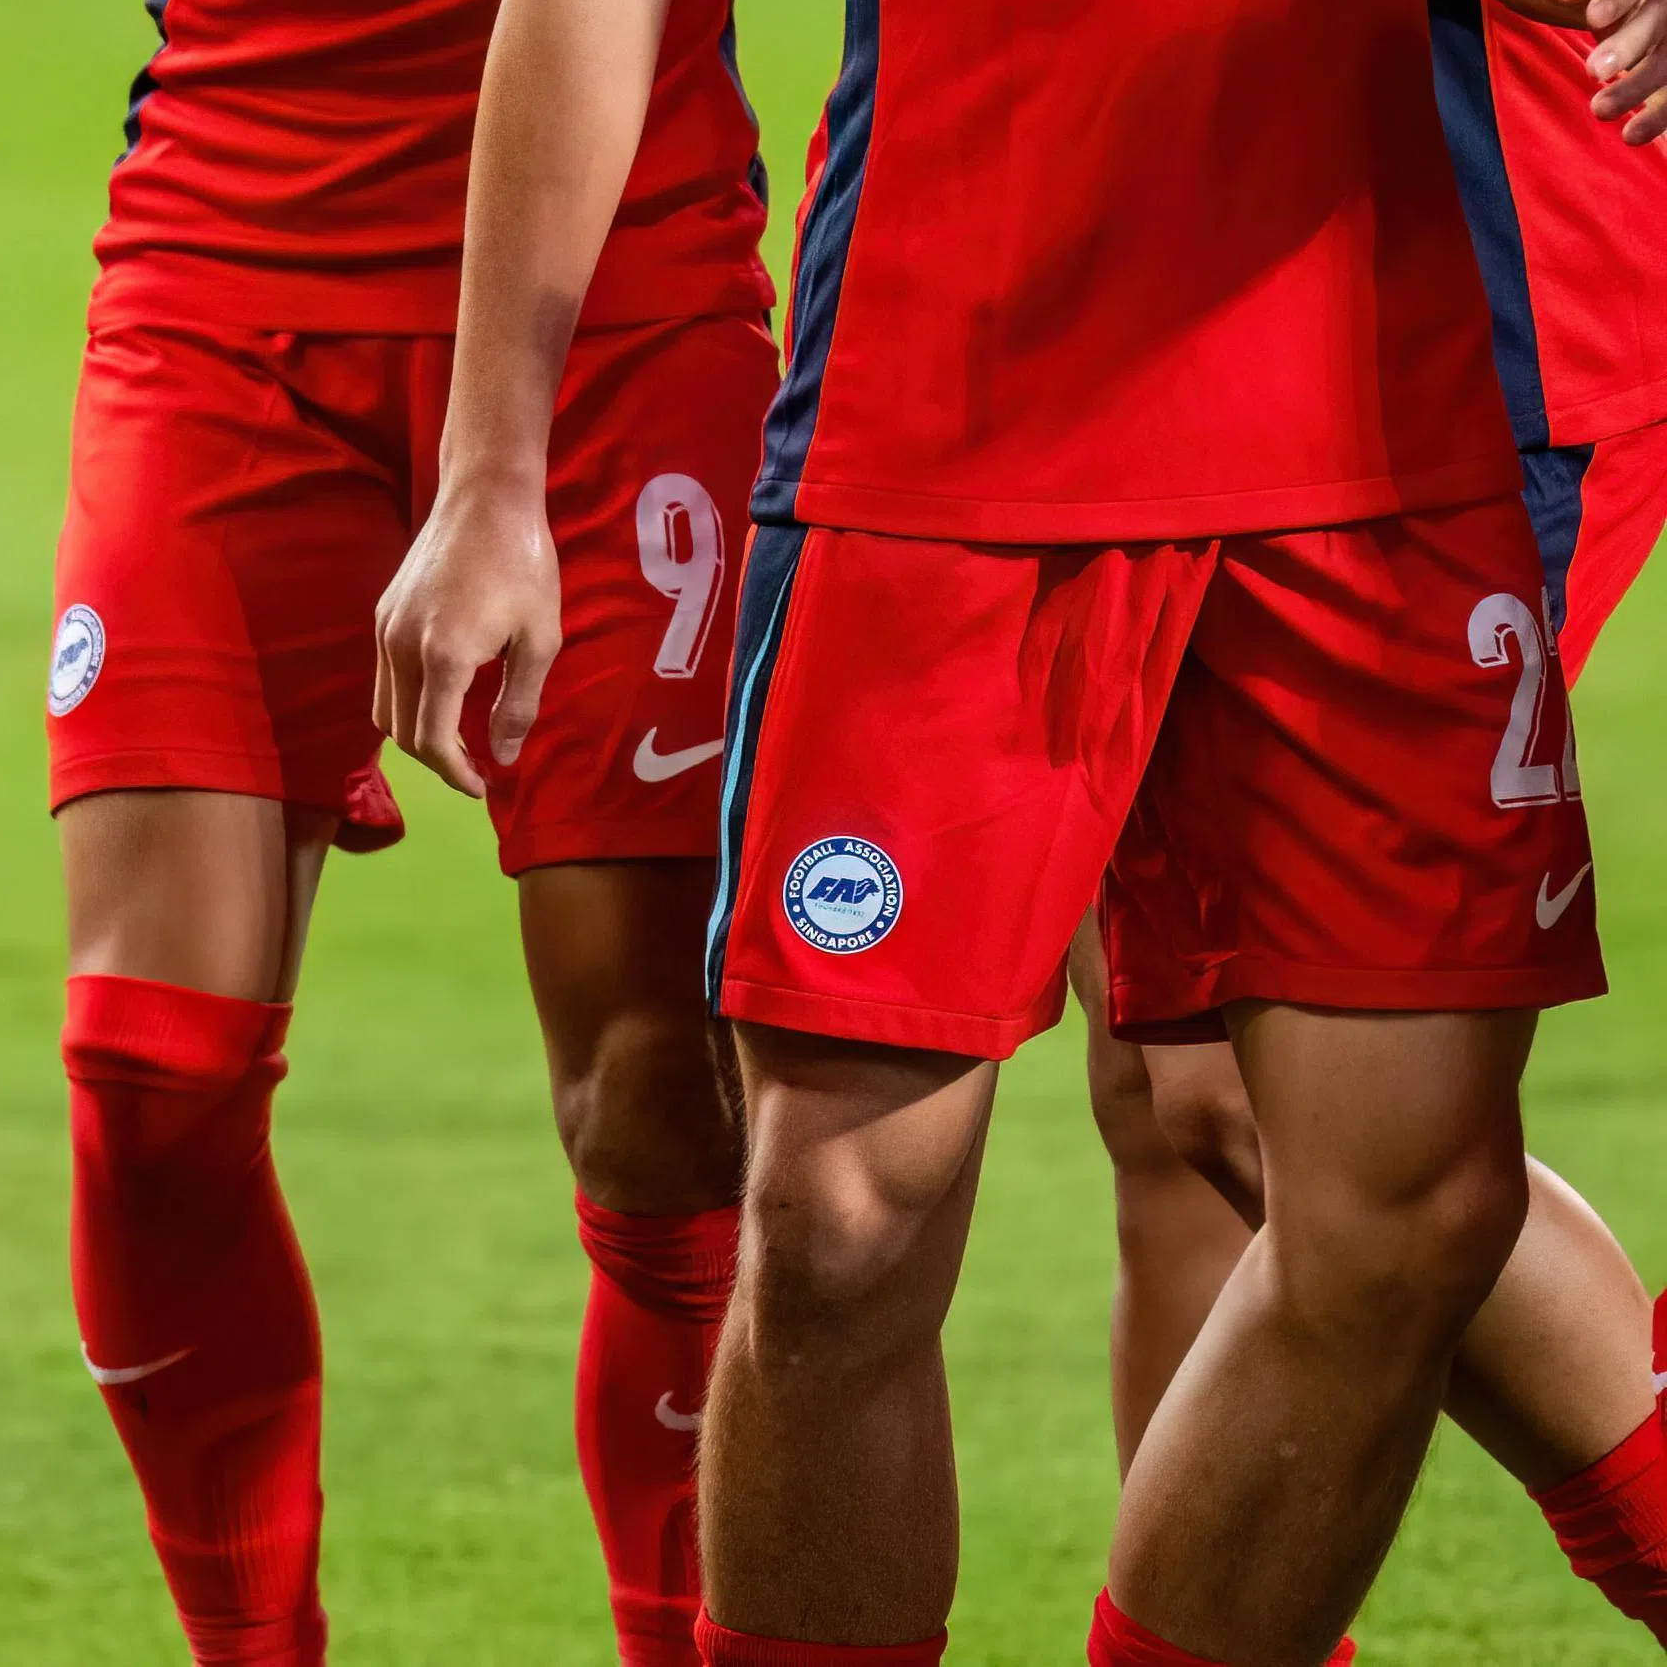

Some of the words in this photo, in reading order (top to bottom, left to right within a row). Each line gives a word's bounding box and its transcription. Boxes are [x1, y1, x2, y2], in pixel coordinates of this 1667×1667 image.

[635, 472, 725, 679] 9
[789, 842, 836, 899] FOOTBALL
[844, 841, 899, 918] ASSOCIATION
[795, 916, 876, 949] SINGAPORE
